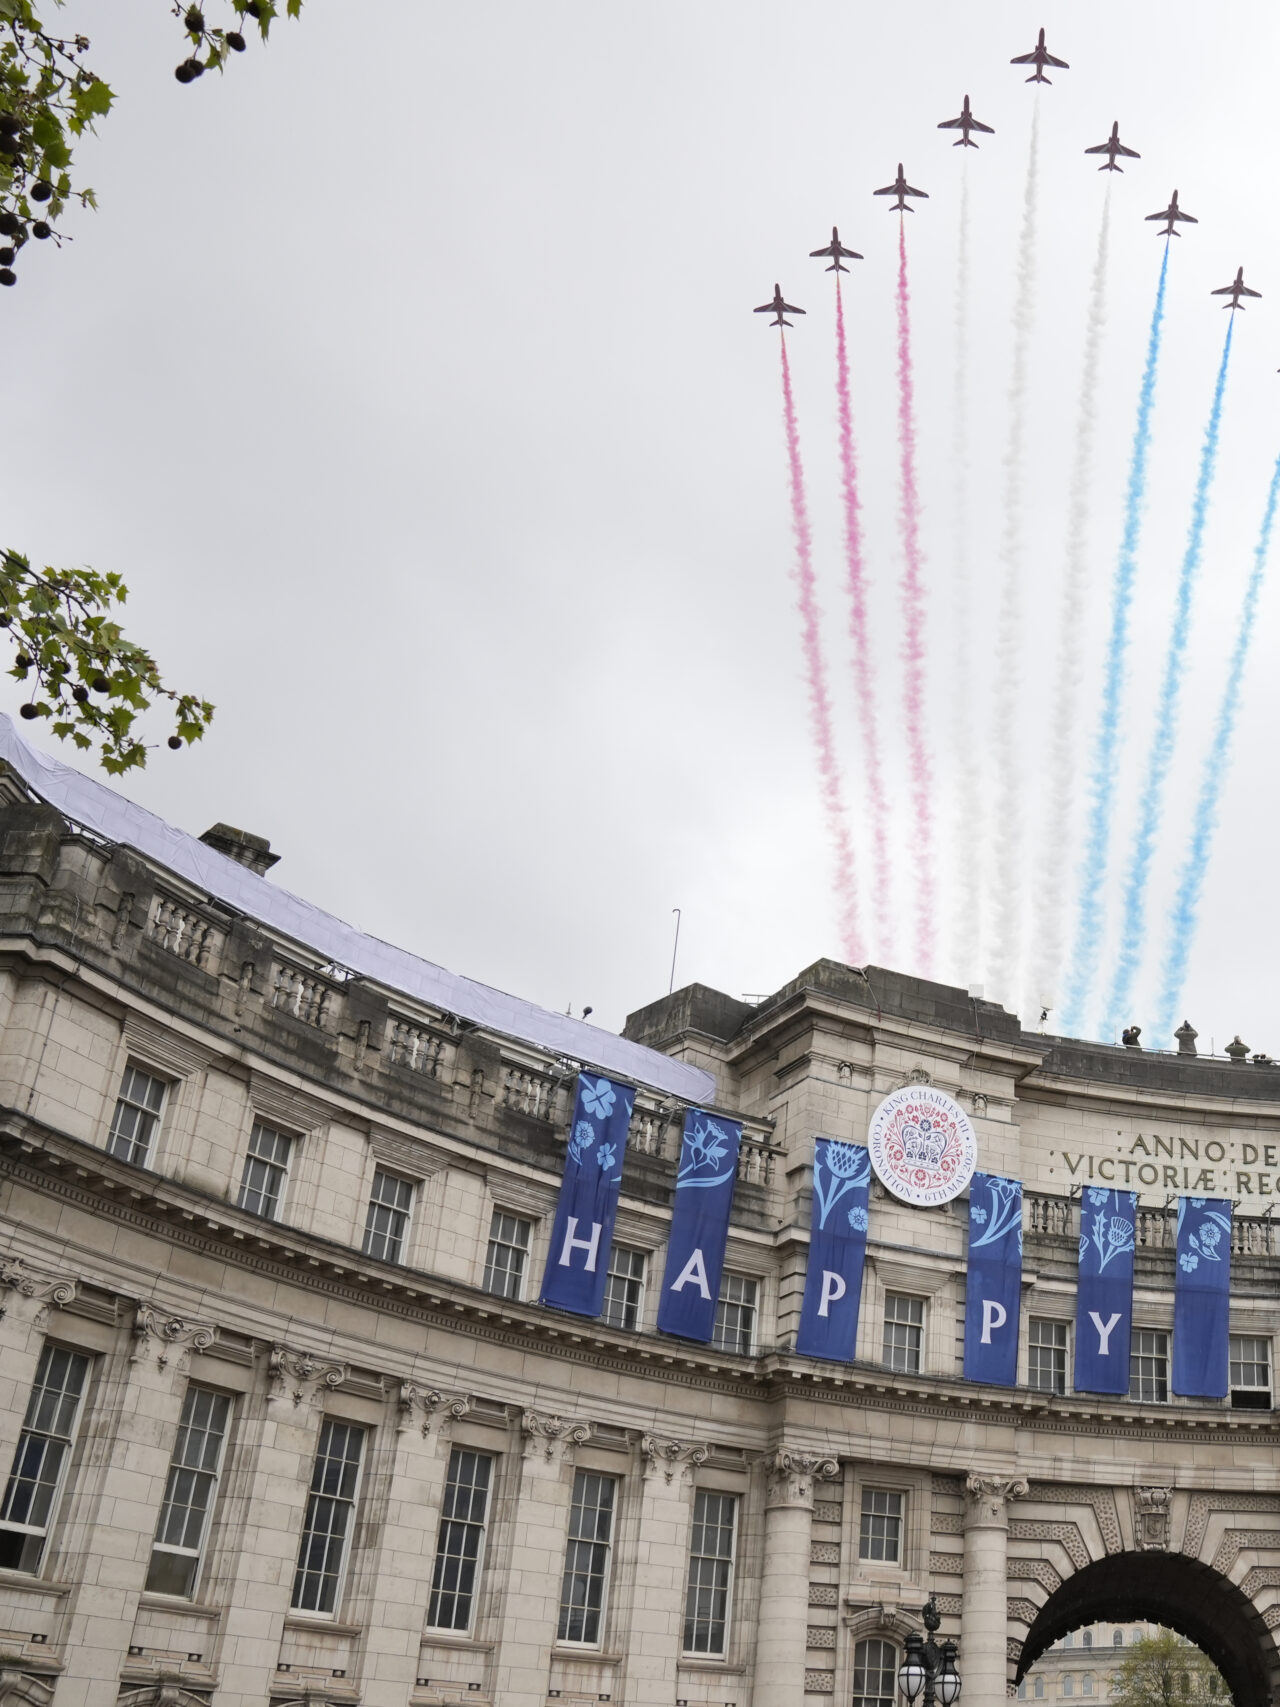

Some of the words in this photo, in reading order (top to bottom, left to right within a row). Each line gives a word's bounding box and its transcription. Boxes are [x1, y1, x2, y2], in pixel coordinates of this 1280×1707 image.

[883, 1094, 909, 1116] KING
[911, 1090, 960, 1120] CHARLES
[958, 1118, 970, 1134] III
[872, 1123, 913, 1199] CORONATION
[947, 1174, 967, 1195] MAY
[964, 1145, 974, 1174] 2023
[1129, 1133, 1226, 1162] ANNO
